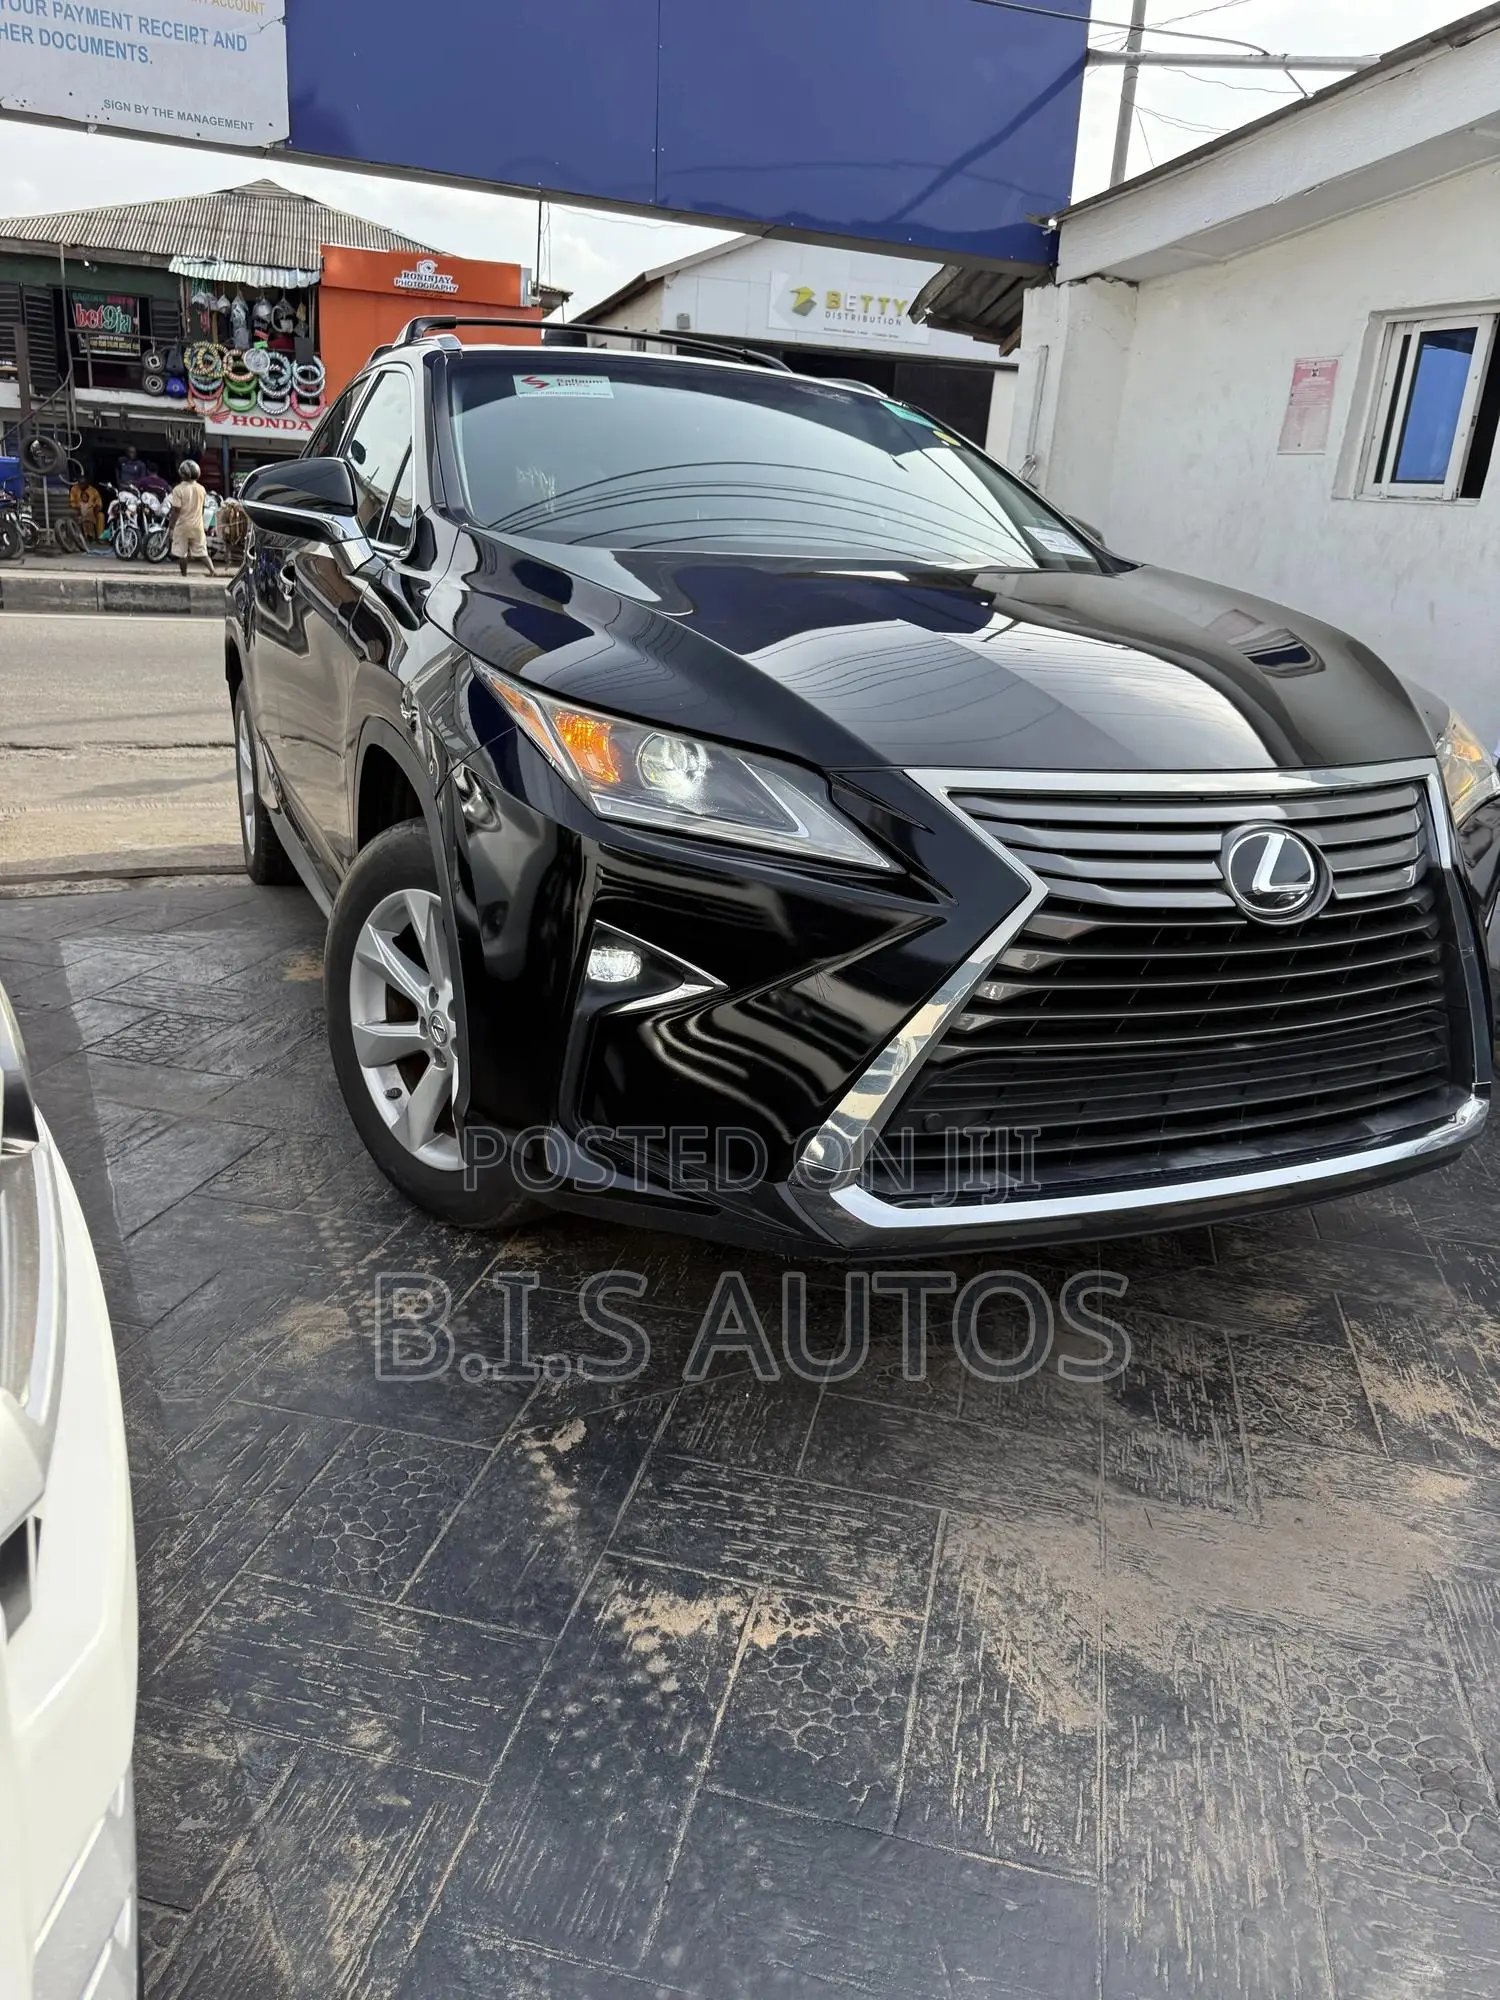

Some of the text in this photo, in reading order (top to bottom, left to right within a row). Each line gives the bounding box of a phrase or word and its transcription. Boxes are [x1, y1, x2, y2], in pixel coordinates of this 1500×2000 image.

[53, 1, 133, 32] PAYMENT
[139, 17, 208, 45] RECEIPT
[213, 30, 247, 52] AND
[39, 28, 153, 65] DOCUMENTS.
[103, 98, 254, 132] SIGN BY THE MANAGEMENT
[395, 279, 458, 292] PHOTOGRAPHY
[825, 290, 908, 317] BETTY
[824, 310, 902, 326] DISTRIBUTION
[231, 414, 314, 432] HONDA
